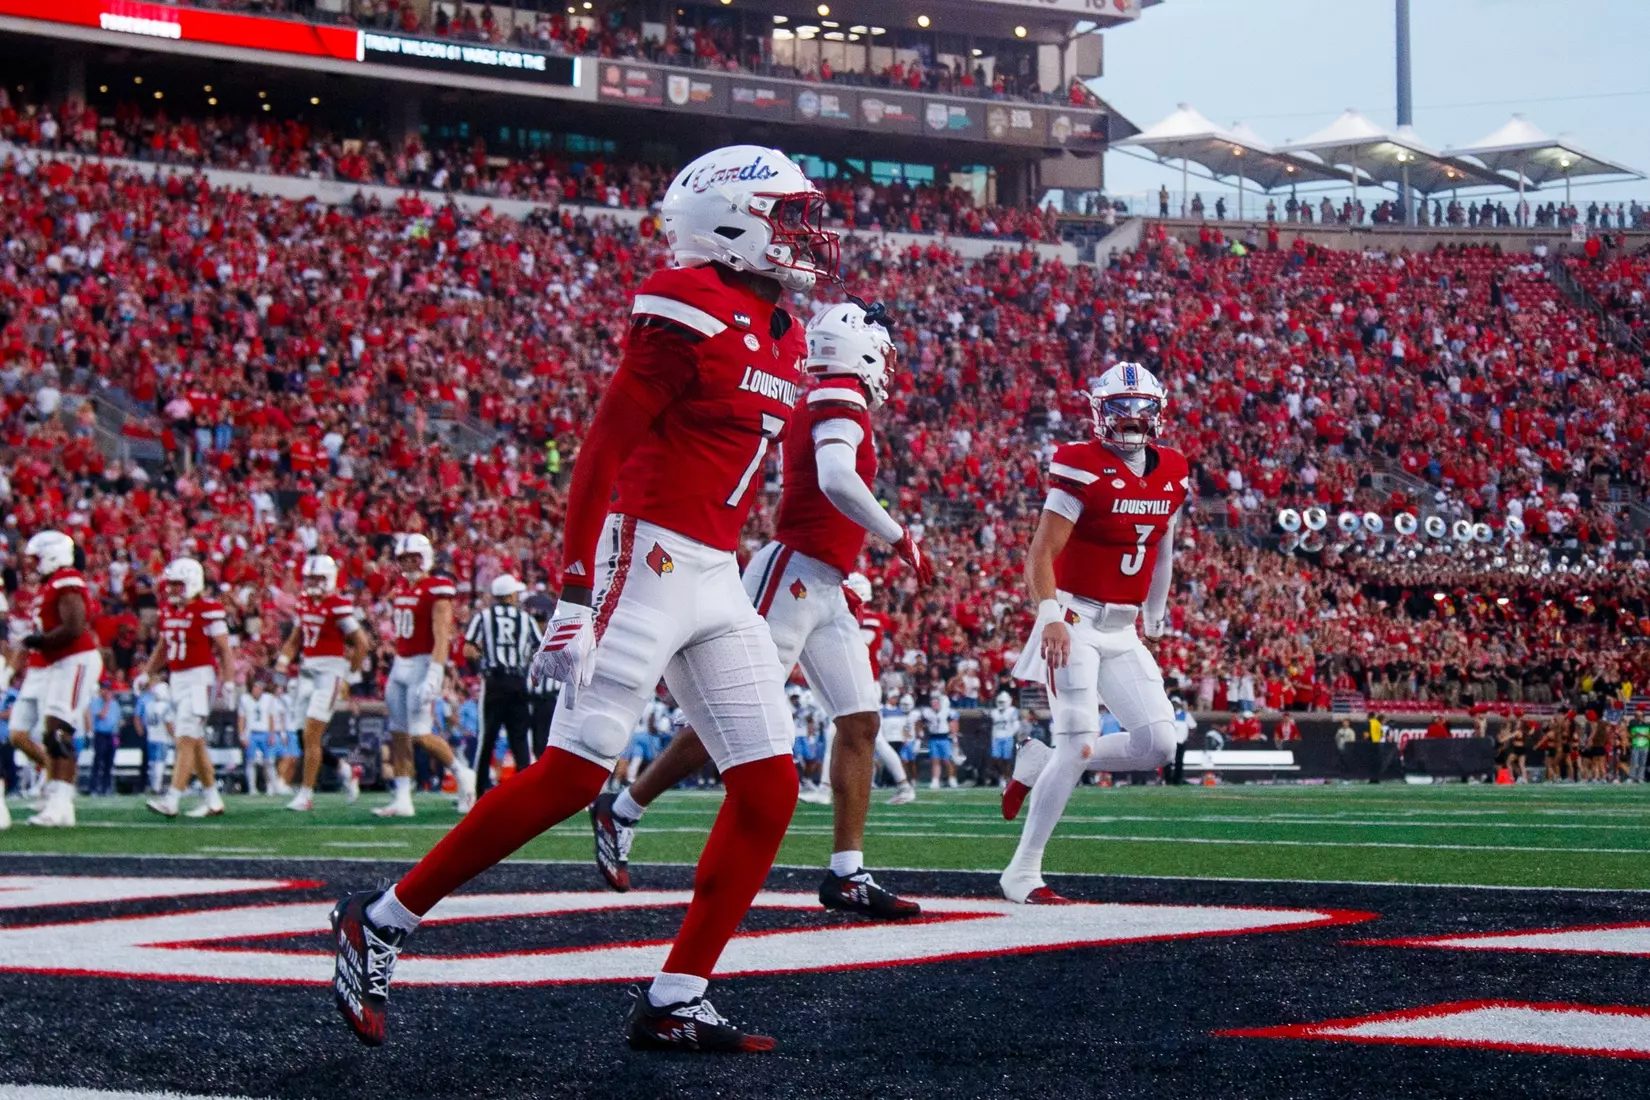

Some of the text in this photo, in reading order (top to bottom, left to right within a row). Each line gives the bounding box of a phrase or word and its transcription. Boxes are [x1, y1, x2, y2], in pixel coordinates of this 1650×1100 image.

[498, 51, 522, 68] FOR
[522, 53, 546, 71] THE
[692, 155, 778, 194] Cards
[725, 411, 786, 508] 7
[1111, 498, 1172, 515] LOUISVILLE
[1120, 523, 1156, 577] 3
[164, 629, 187, 661] 51
[496, 617, 517, 644] R
